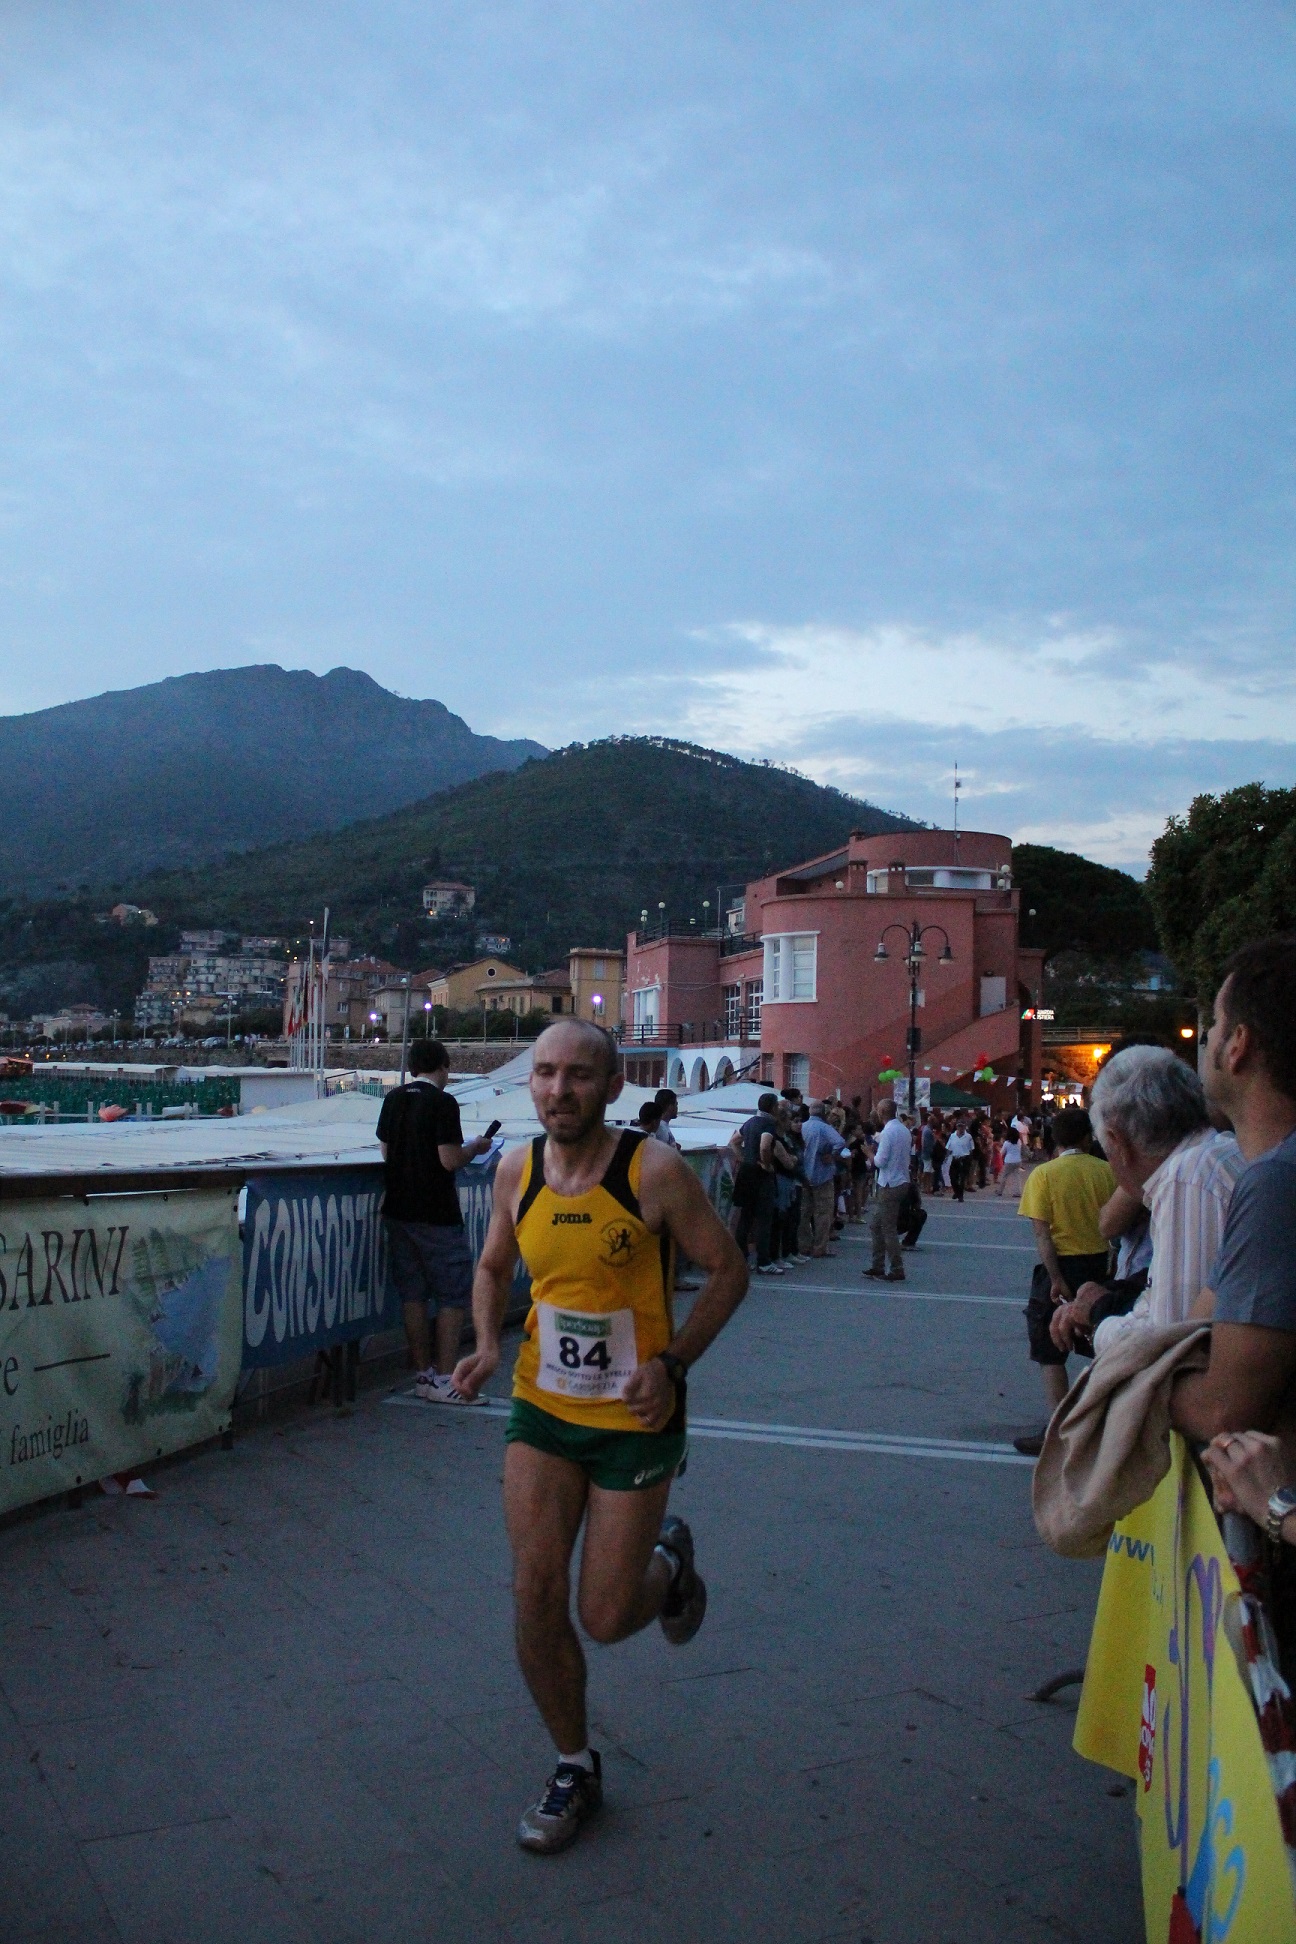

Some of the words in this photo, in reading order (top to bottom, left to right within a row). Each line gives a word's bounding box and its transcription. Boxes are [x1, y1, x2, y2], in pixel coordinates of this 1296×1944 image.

[246, 1193, 388, 1348] CONSORZIO
[559, 1336, 612, 1371] 84
[9, 1408, 89, 1466] famiglia
